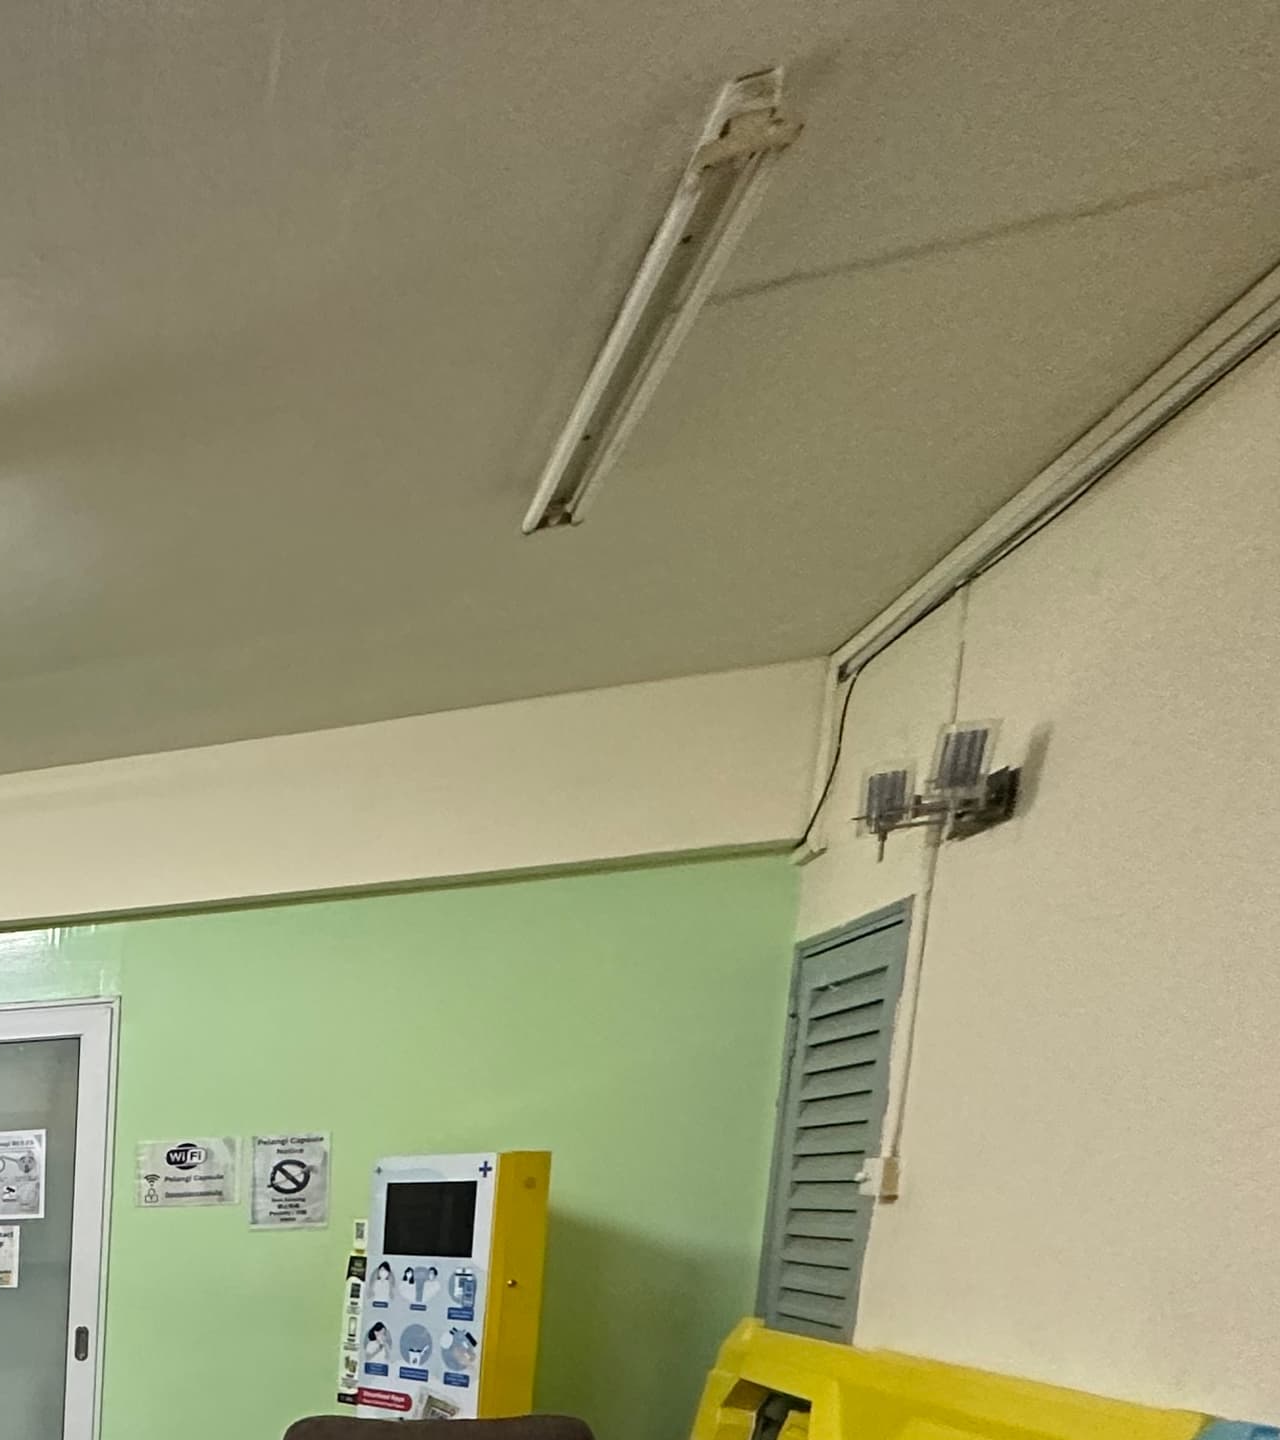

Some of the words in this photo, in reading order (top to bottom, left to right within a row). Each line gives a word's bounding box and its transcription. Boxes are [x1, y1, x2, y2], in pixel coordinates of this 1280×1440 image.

[258, 1138, 289, 1146] Pelangi
[290, 1137, 324, 1145] Capsule
[193, 1174, 224, 1182] Capsule
